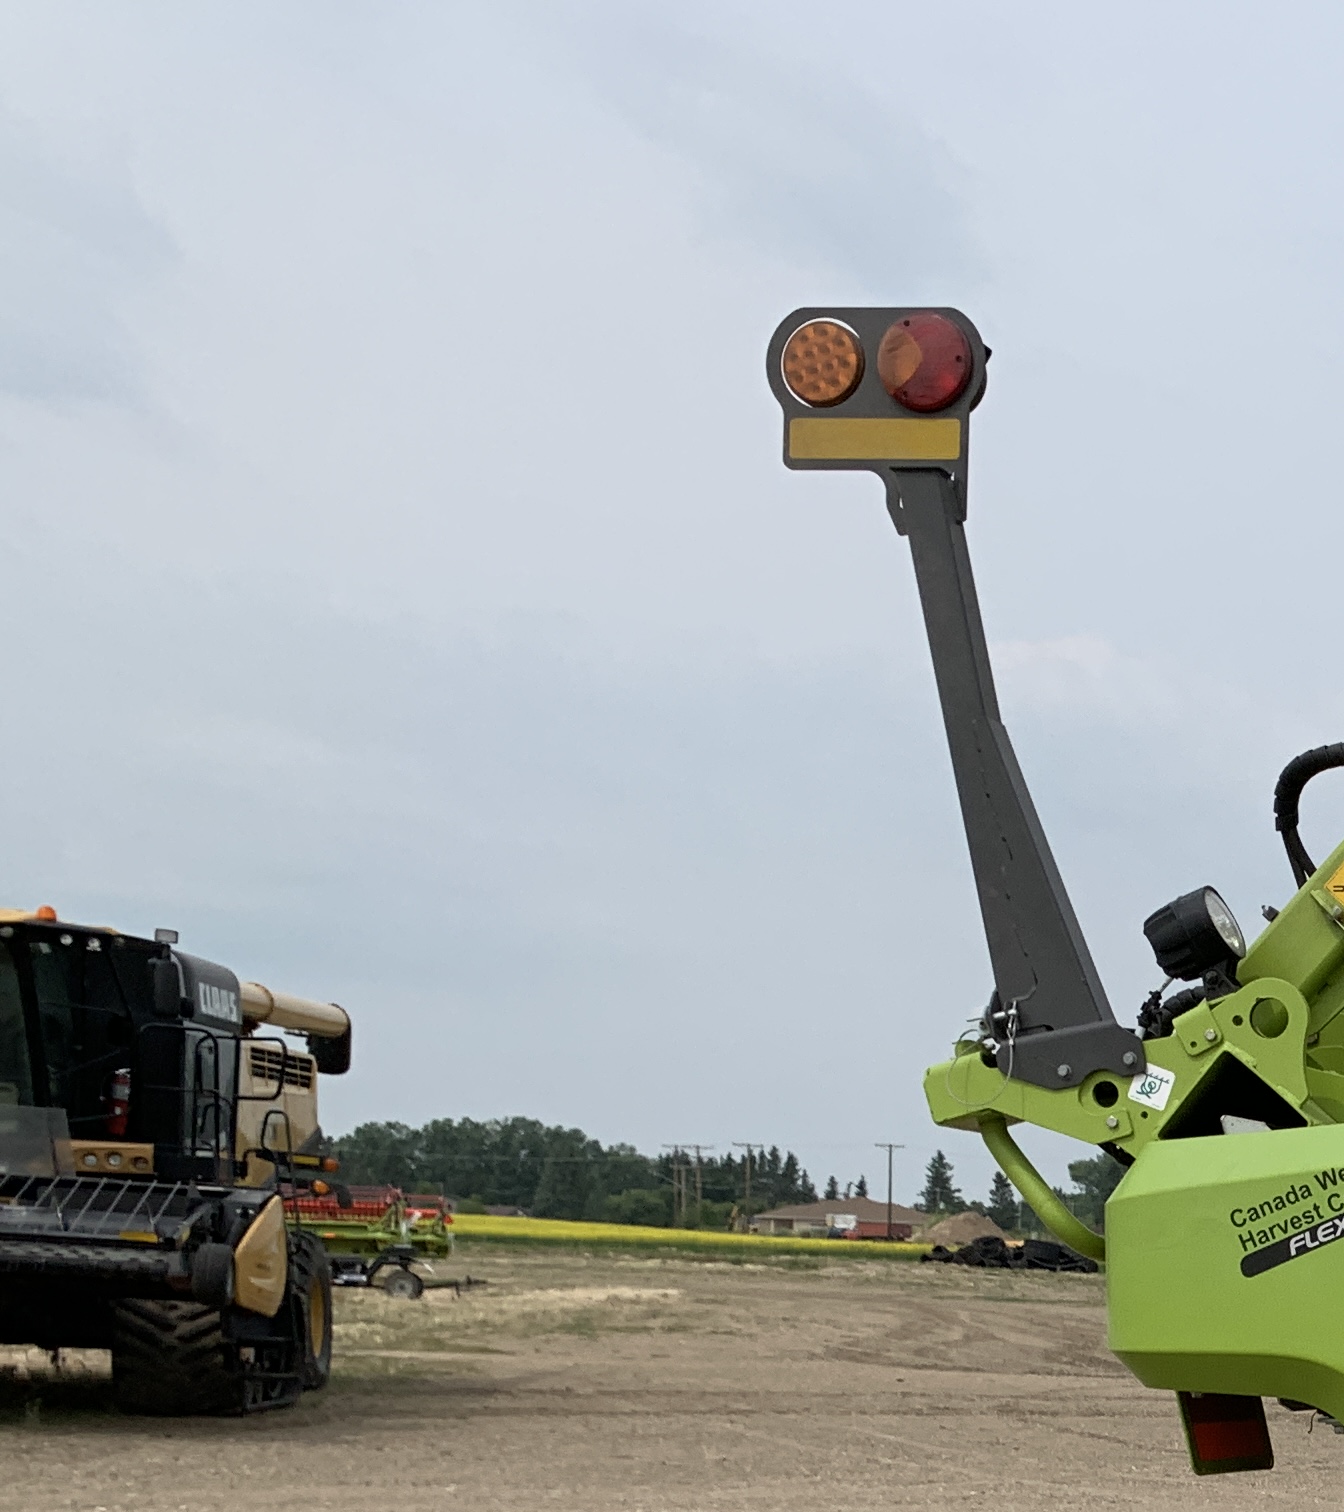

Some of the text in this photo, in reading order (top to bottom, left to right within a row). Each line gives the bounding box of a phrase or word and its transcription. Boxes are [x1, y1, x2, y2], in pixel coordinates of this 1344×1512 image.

[198, 981, 238, 1022] CLAAS
[1229, 1184, 1313, 1229] Canada
[1237, 1203, 1325, 1252] Harvest
